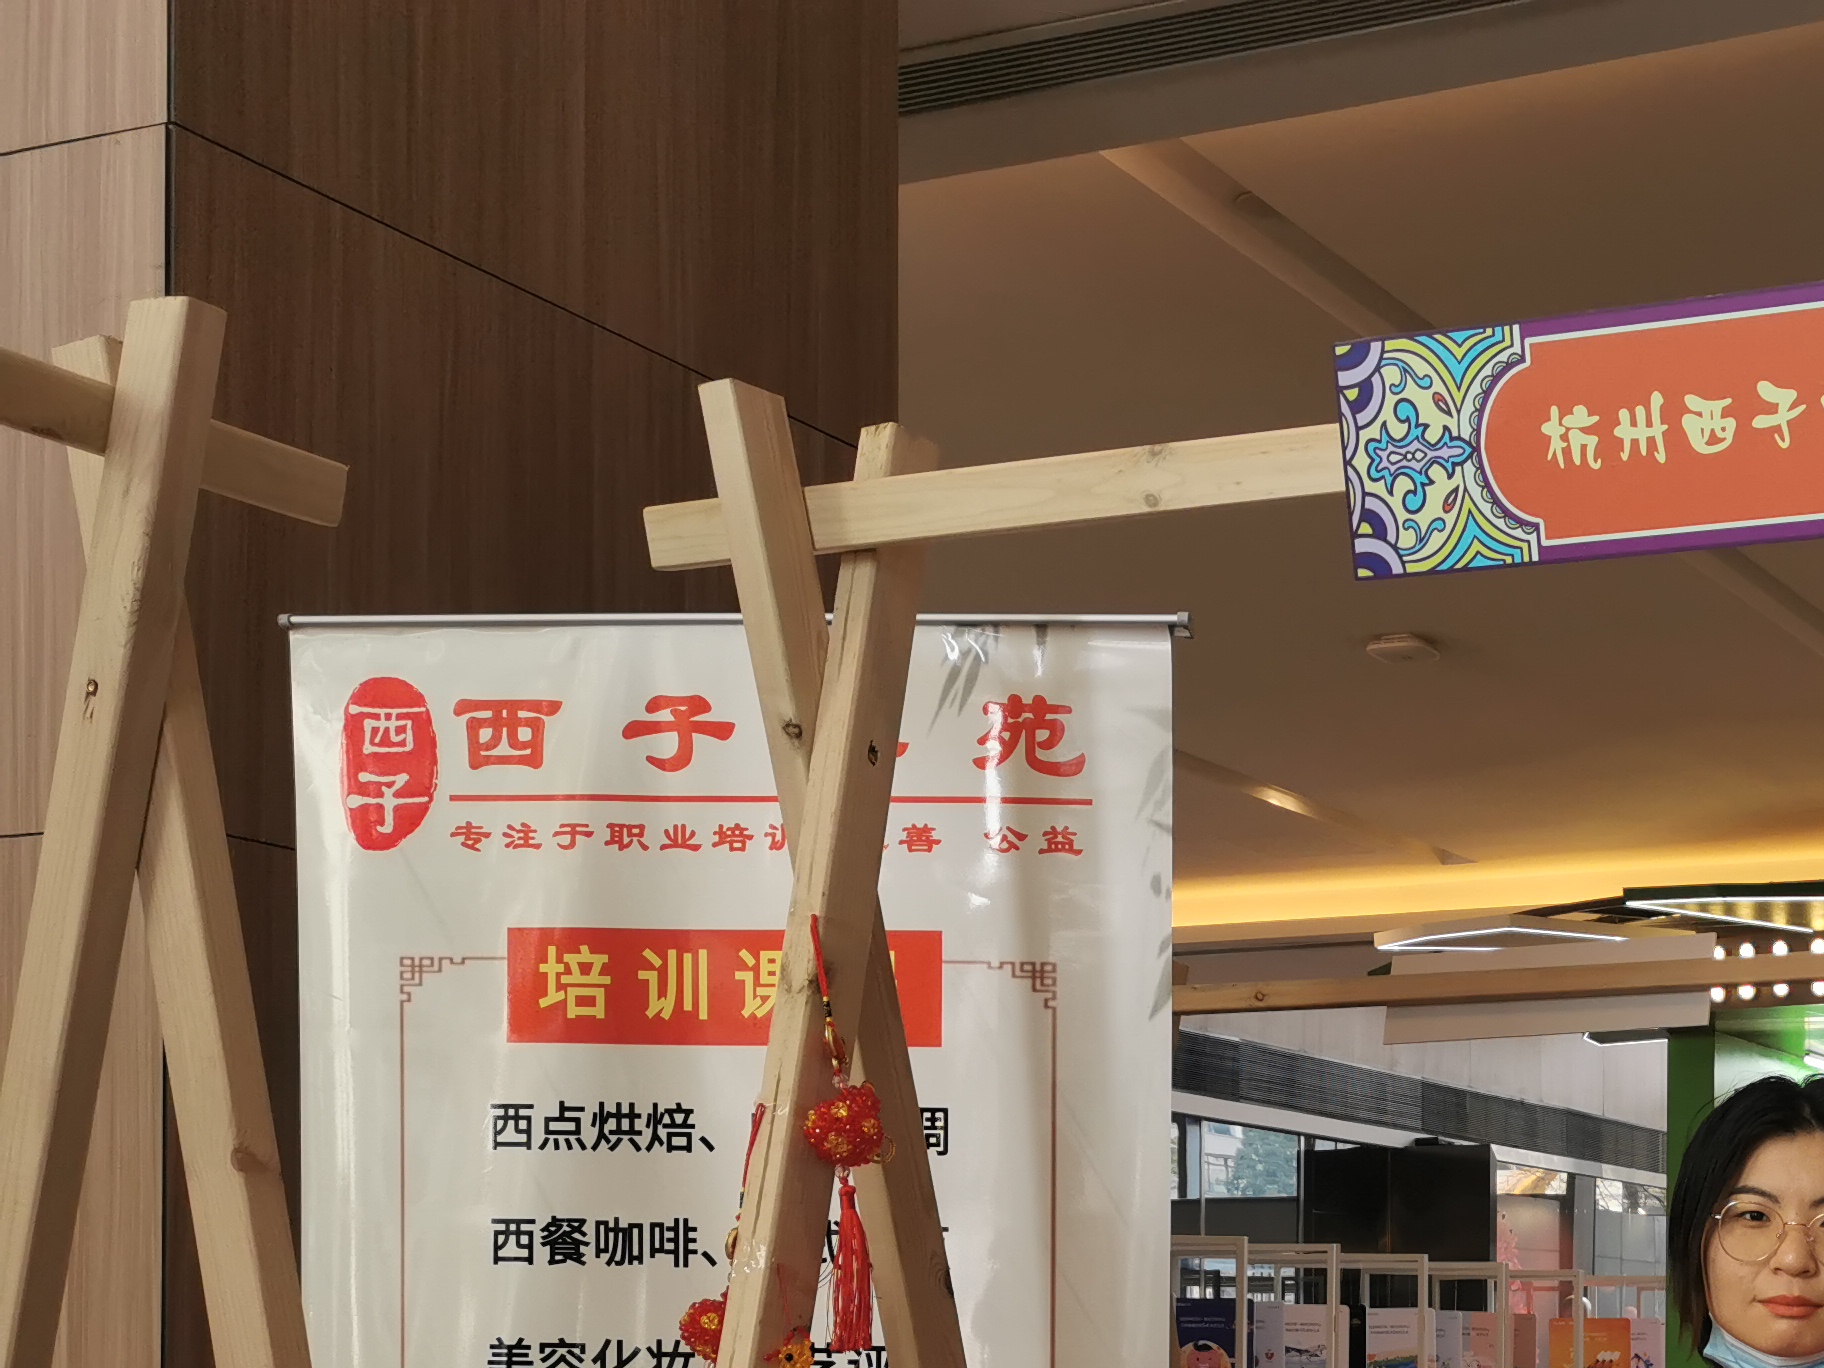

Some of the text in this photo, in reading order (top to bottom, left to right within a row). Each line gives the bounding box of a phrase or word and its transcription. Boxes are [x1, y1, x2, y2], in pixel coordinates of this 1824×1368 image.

[453, 694, 1087, 778] 西子苑
[539, 945, 897, 1021] 培训课
